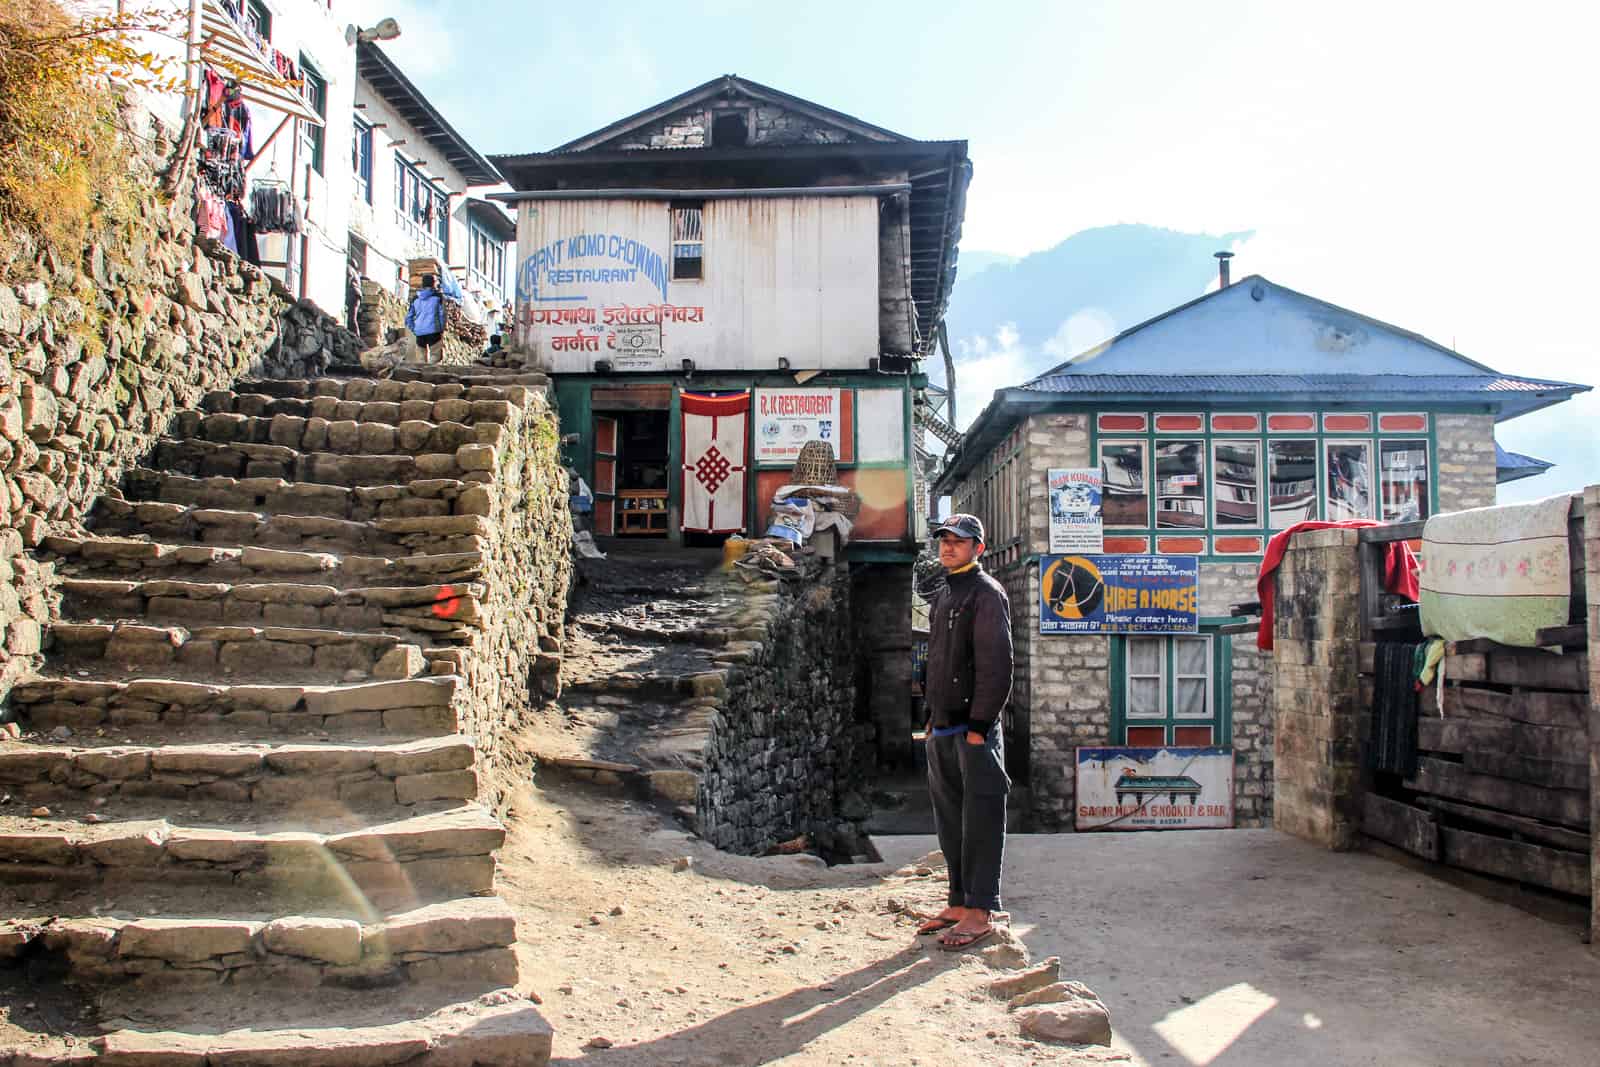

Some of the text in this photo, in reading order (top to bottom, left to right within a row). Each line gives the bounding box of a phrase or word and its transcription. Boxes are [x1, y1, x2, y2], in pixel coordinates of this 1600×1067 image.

[547, 268, 639, 285] RESTAURANT
[567, 234, 606, 260] MOMO
[609, 235, 668, 302] CHOWMIN
[778, 395, 834, 416] RESTAURENT
[1053, 517, 1101, 525] RESTAURANT
[1104, 584, 1198, 613] HIRE A HORSE
[1105, 614, 1132, 623] Please
